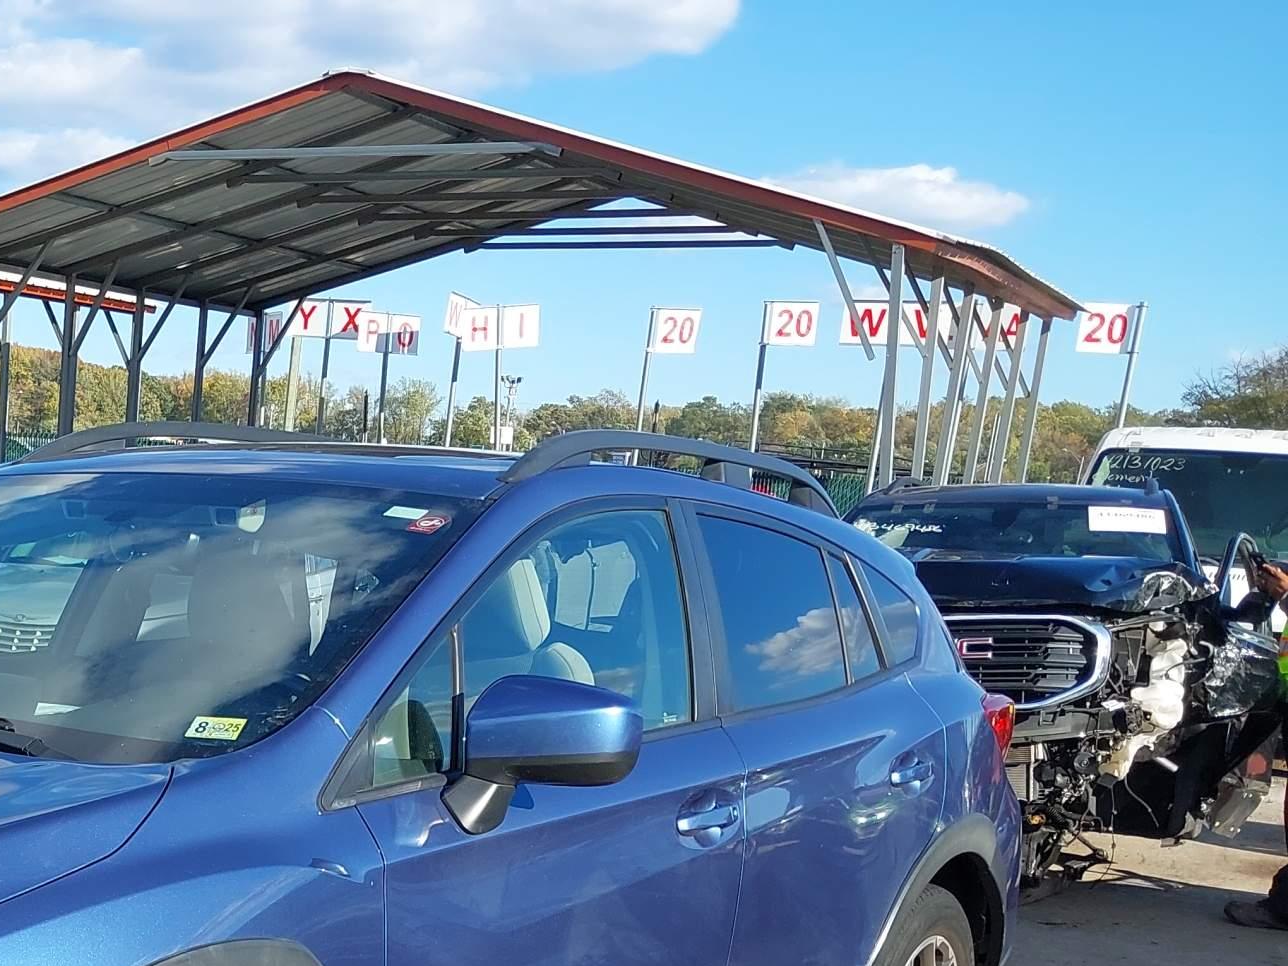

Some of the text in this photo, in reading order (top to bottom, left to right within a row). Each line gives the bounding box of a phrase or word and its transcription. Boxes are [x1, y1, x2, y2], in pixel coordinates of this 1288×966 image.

[299, 305, 362, 333] Y X
[367, 319, 380, 345] P
[471, 315, 489, 342] H
[660, 316, 695, 344] 20
[775, 309, 813, 338] 20
[850, 308, 887, 337] W
[1083, 313, 1128, 344] 20
[195, 721, 241, 733] 8 25
